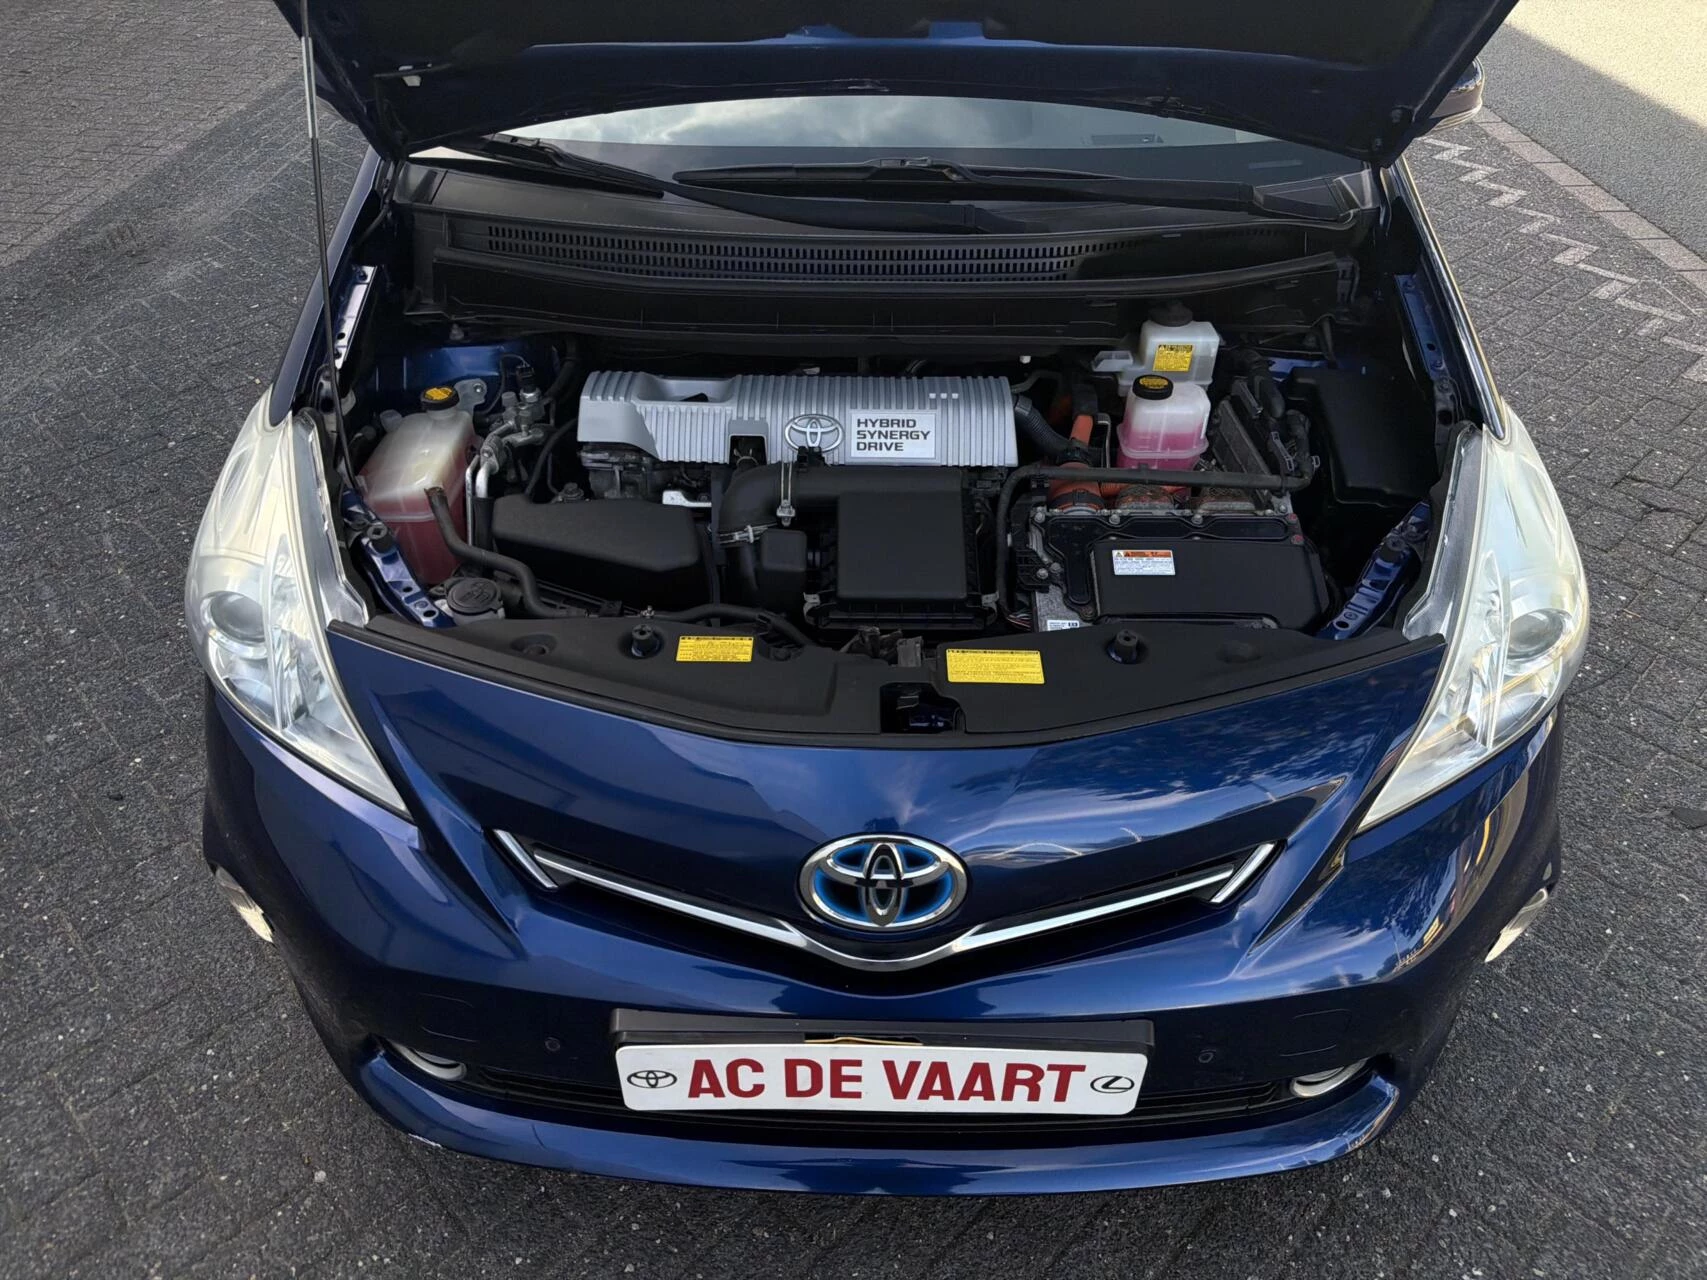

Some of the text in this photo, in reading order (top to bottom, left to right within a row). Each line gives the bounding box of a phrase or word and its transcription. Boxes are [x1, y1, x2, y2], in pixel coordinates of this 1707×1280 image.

[856, 418, 917, 429] HYBRID
[856, 430, 931, 441] SYNERGY
[856, 441, 904, 452] DRIVE
[688, 1058, 1087, 1103] AC DE VAART
